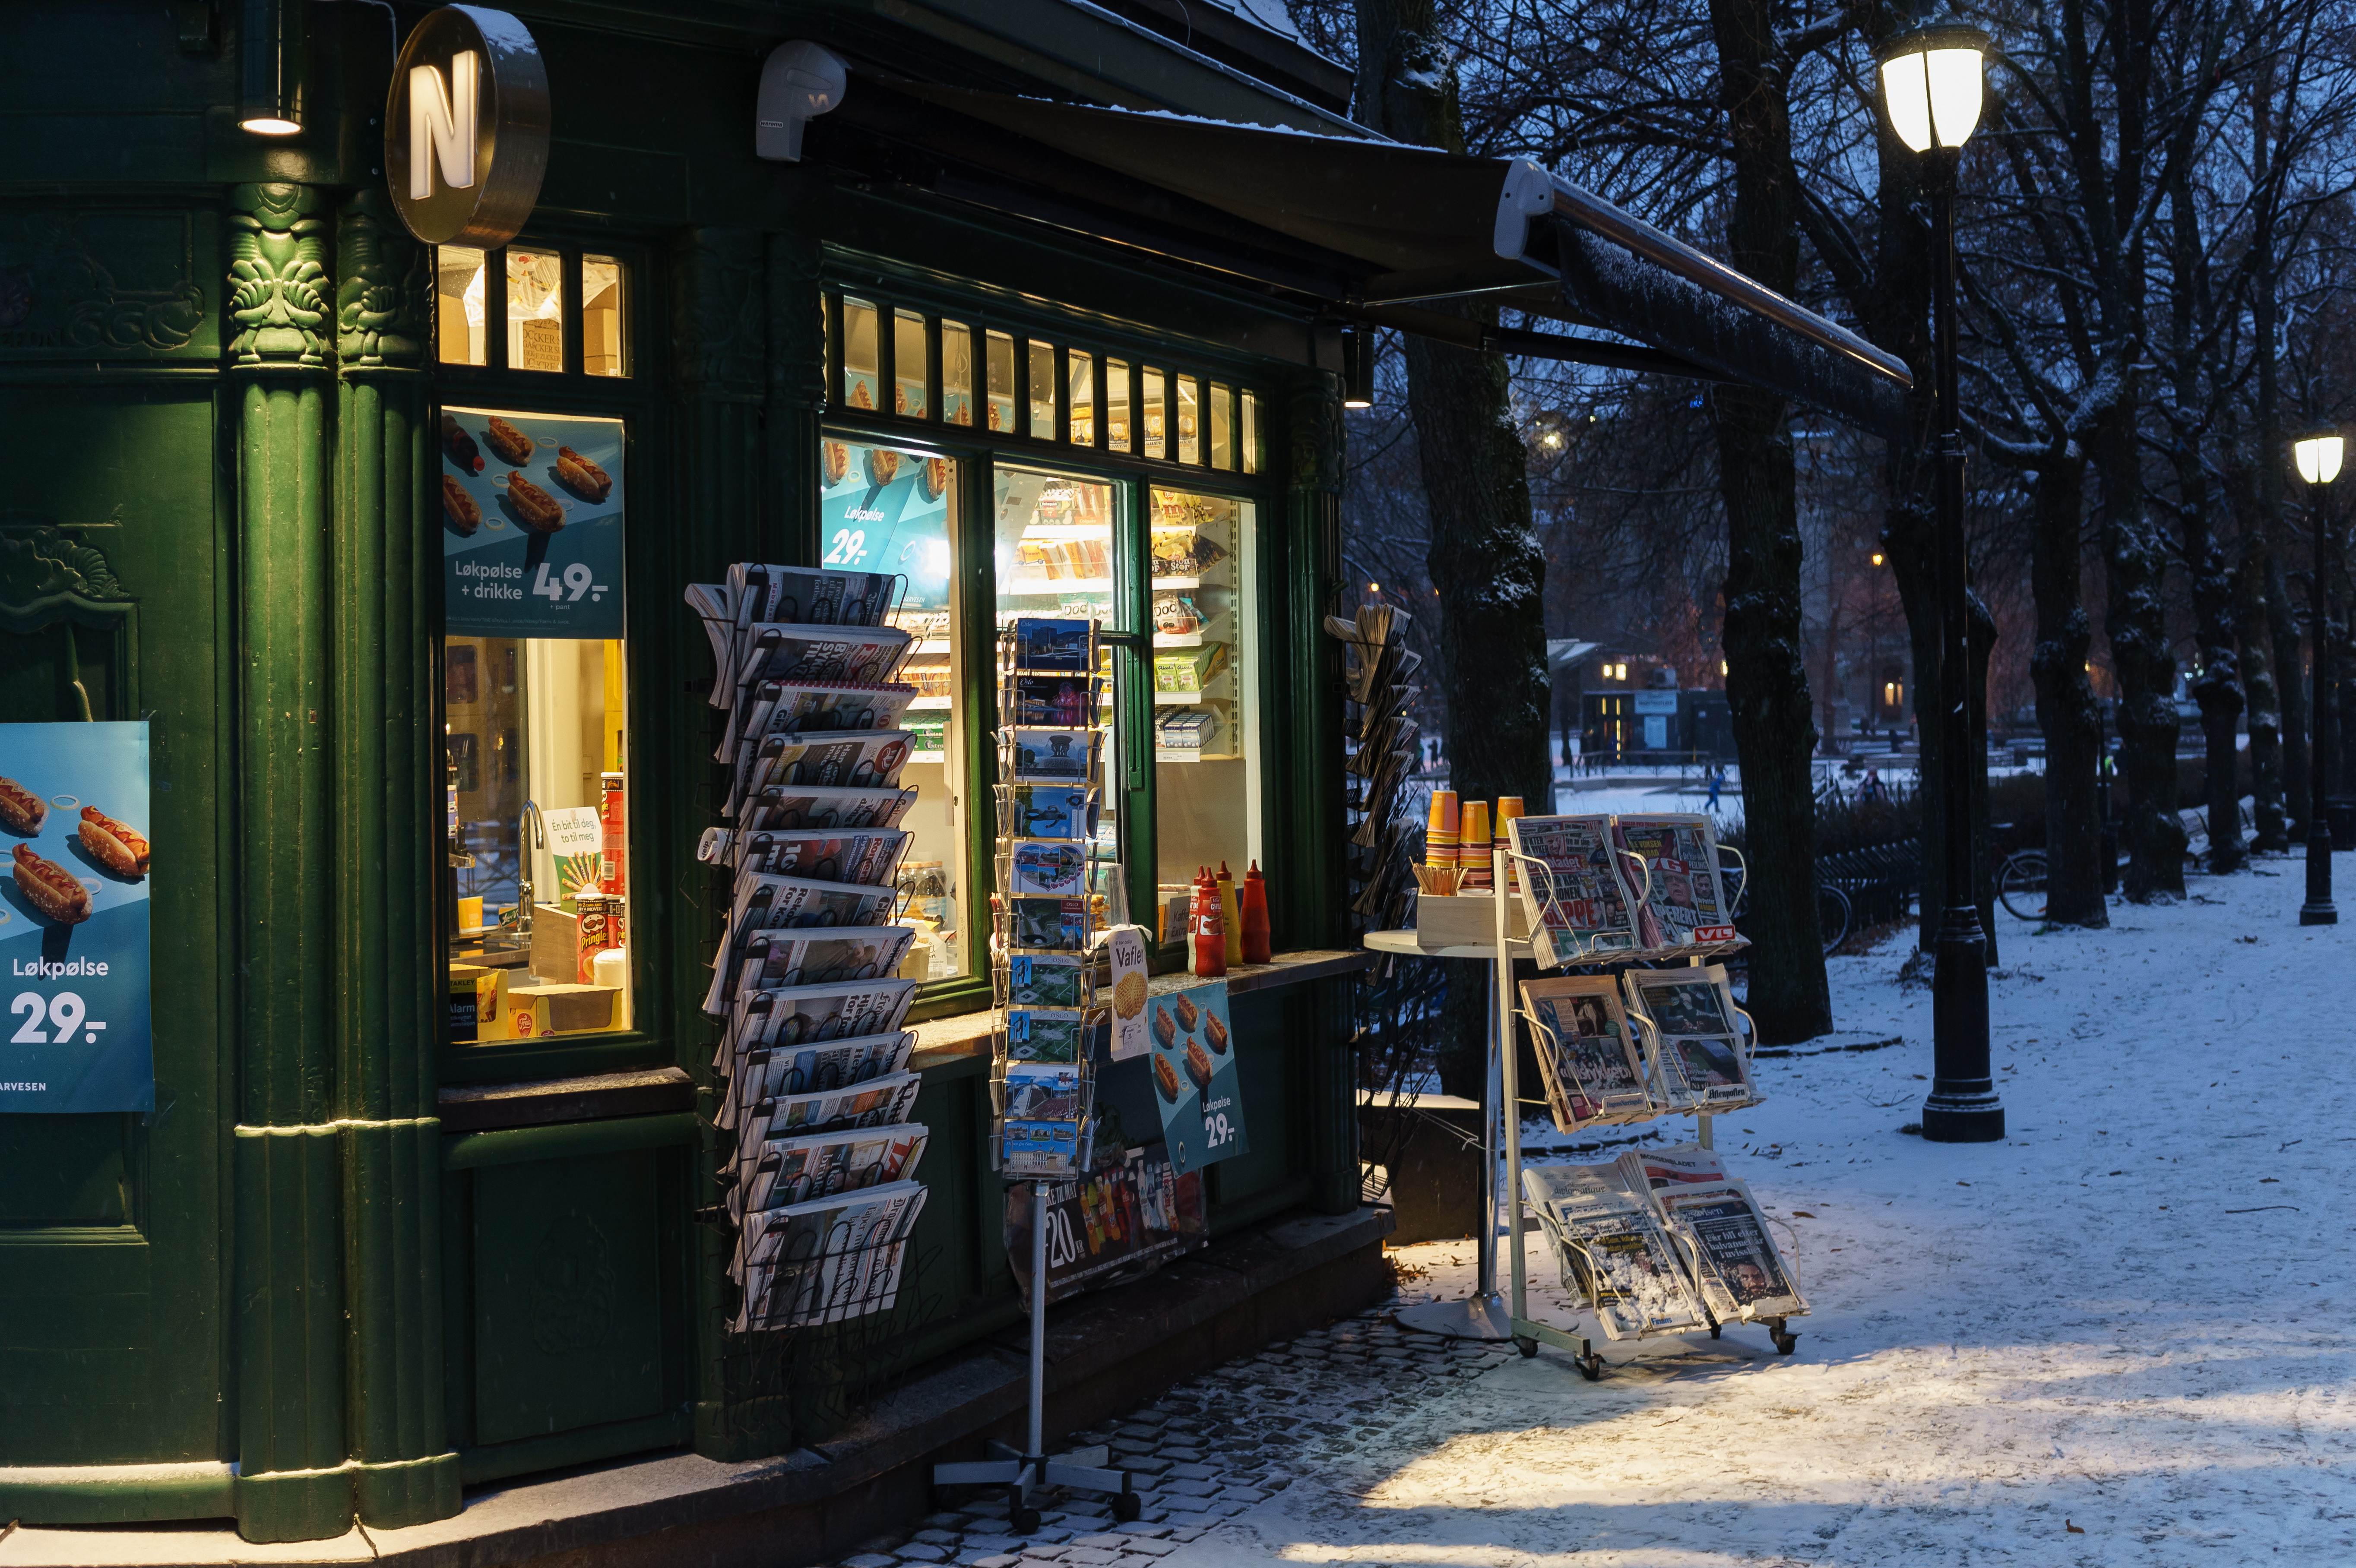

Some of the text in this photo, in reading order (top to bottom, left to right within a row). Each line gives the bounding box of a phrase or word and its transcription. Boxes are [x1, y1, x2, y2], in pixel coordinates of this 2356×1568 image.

[410, 50, 478, 200] N
[845, 505, 884, 522] Løkpølse
[456, 560, 522, 580] Løkpølse
[462, 582, 522, 600] + drikke
[816, 586, 827, 607] sate
[801, 642, 824, 662] TIL
[772, 709, 788, 728] Gir
[837, 744, 853, 763] Han
[863, 746, 878, 769] DAGN
[843, 798, 867, 823] dårlig
[552, 819, 562, 831] Én
[563, 820, 572, 830] bit
[581, 817, 596, 829] deg,
[561, 834, 569, 843] to
[579, 832, 595, 842] meg
[1521, 836, 1544, 845] FRKTER
[844, 837, 861, 875] terminalen
[1528, 855, 1581, 870] Dbladet
[1631, 857, 1683, 873] VG
[1531, 873, 1581, 889] DEROR KAN
[782, 886, 798, 906] for
[1534, 887, 1582, 901] PENJONEN
[1173, 908, 1189, 923] Kaffe
[1539, 898, 1597, 926] GLIPPE
[1171, 926, 1187, 937] Extra
[1696, 927, 1734, 940] VG
[581, 931, 608, 952] Pringles
[1115, 945, 1144, 968] Vafler
[13, 956, 108, 980] Løkpølse
[844, 994, 860, 1015] for
[849, 1048, 864, 1071] Her
[1708, 1088, 1745, 1101] Aftenposten
[1202, 1096, 1231, 1115] Løkpølse
[881, 1135, 915, 1182] TA
[1640, 1153, 1696, 1168] MORGENBLADET
[1055, 1182, 1077, 1203] TIL MAT
[1554, 1185, 1606, 1199] diplomatique
[857, 1204, 878, 1231] Taper
[1046, 1208, 1077, 1268] 20
[1075, 1239, 1085, 1254] KR
[1705, 1228, 1759, 1242] Får bli etter
[1709, 1236, 1764, 1251] halvannet år
[1725, 1247, 1763, 1258] uvisshet
[1651, 1316, 1673, 1325] Finans
